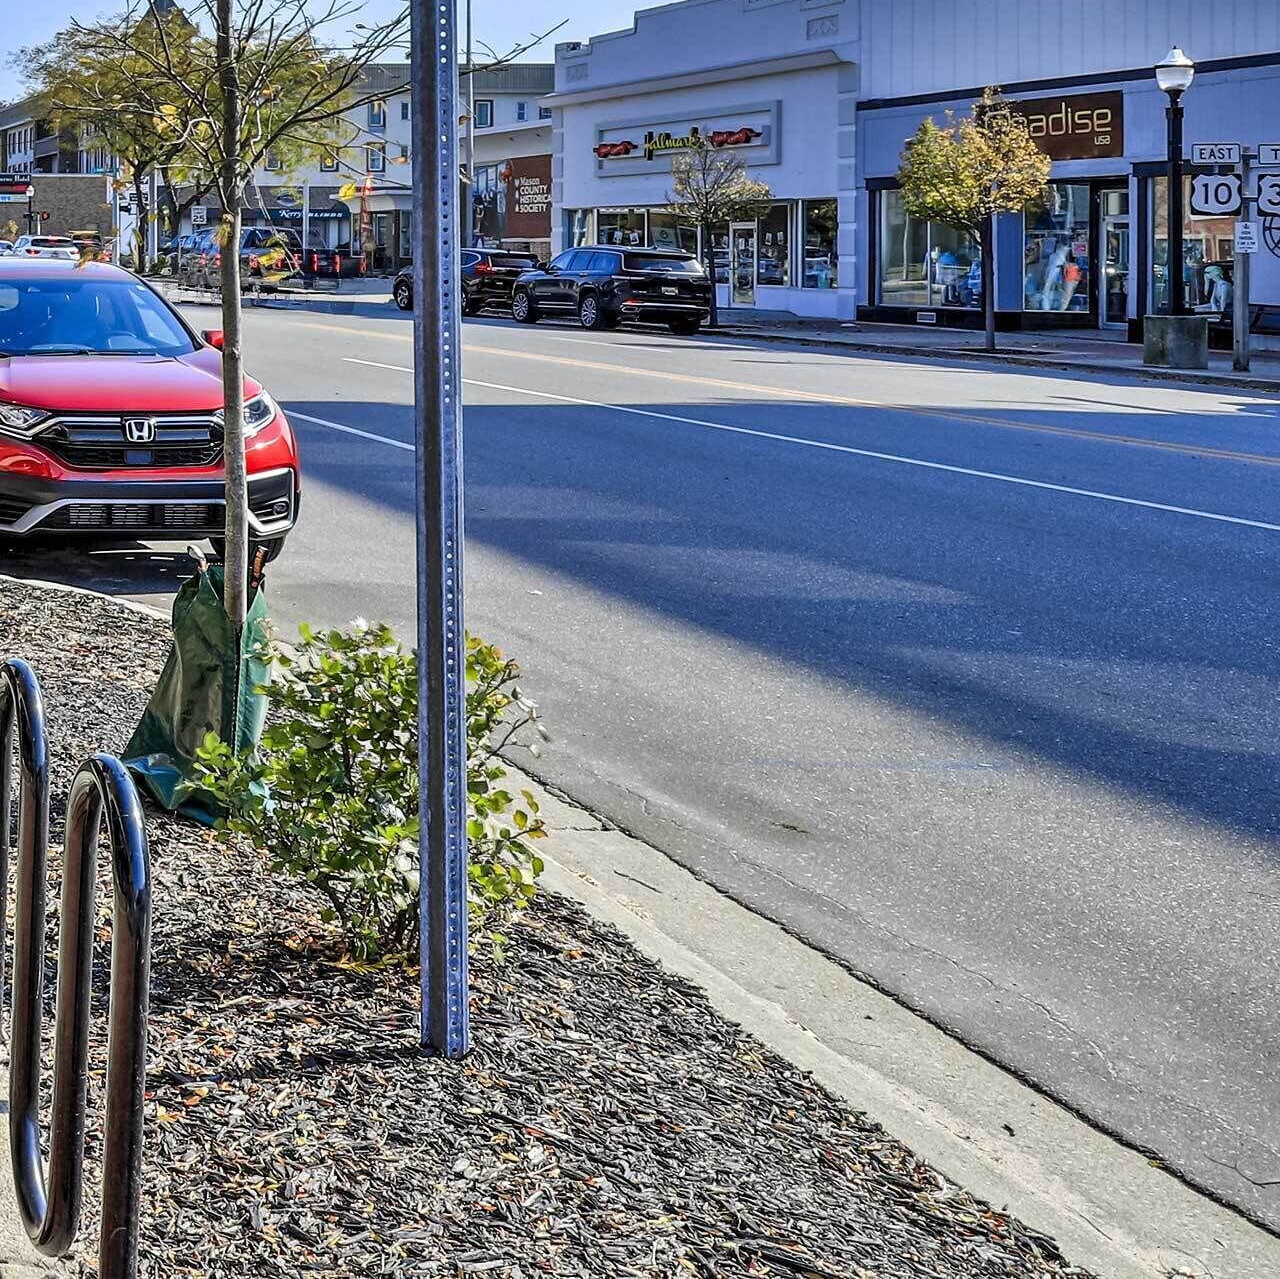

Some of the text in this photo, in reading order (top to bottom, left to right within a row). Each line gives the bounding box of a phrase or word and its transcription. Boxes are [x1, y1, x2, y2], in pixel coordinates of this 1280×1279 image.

[1094, 135, 1111, 145] usa
[1200, 148, 1233, 160] EAST
[520, 185, 548, 195] COUNTY
[1202, 183, 1232, 205] 10
[520, 204, 547, 213] SOCIETY
[193, 215, 206, 223] 25
